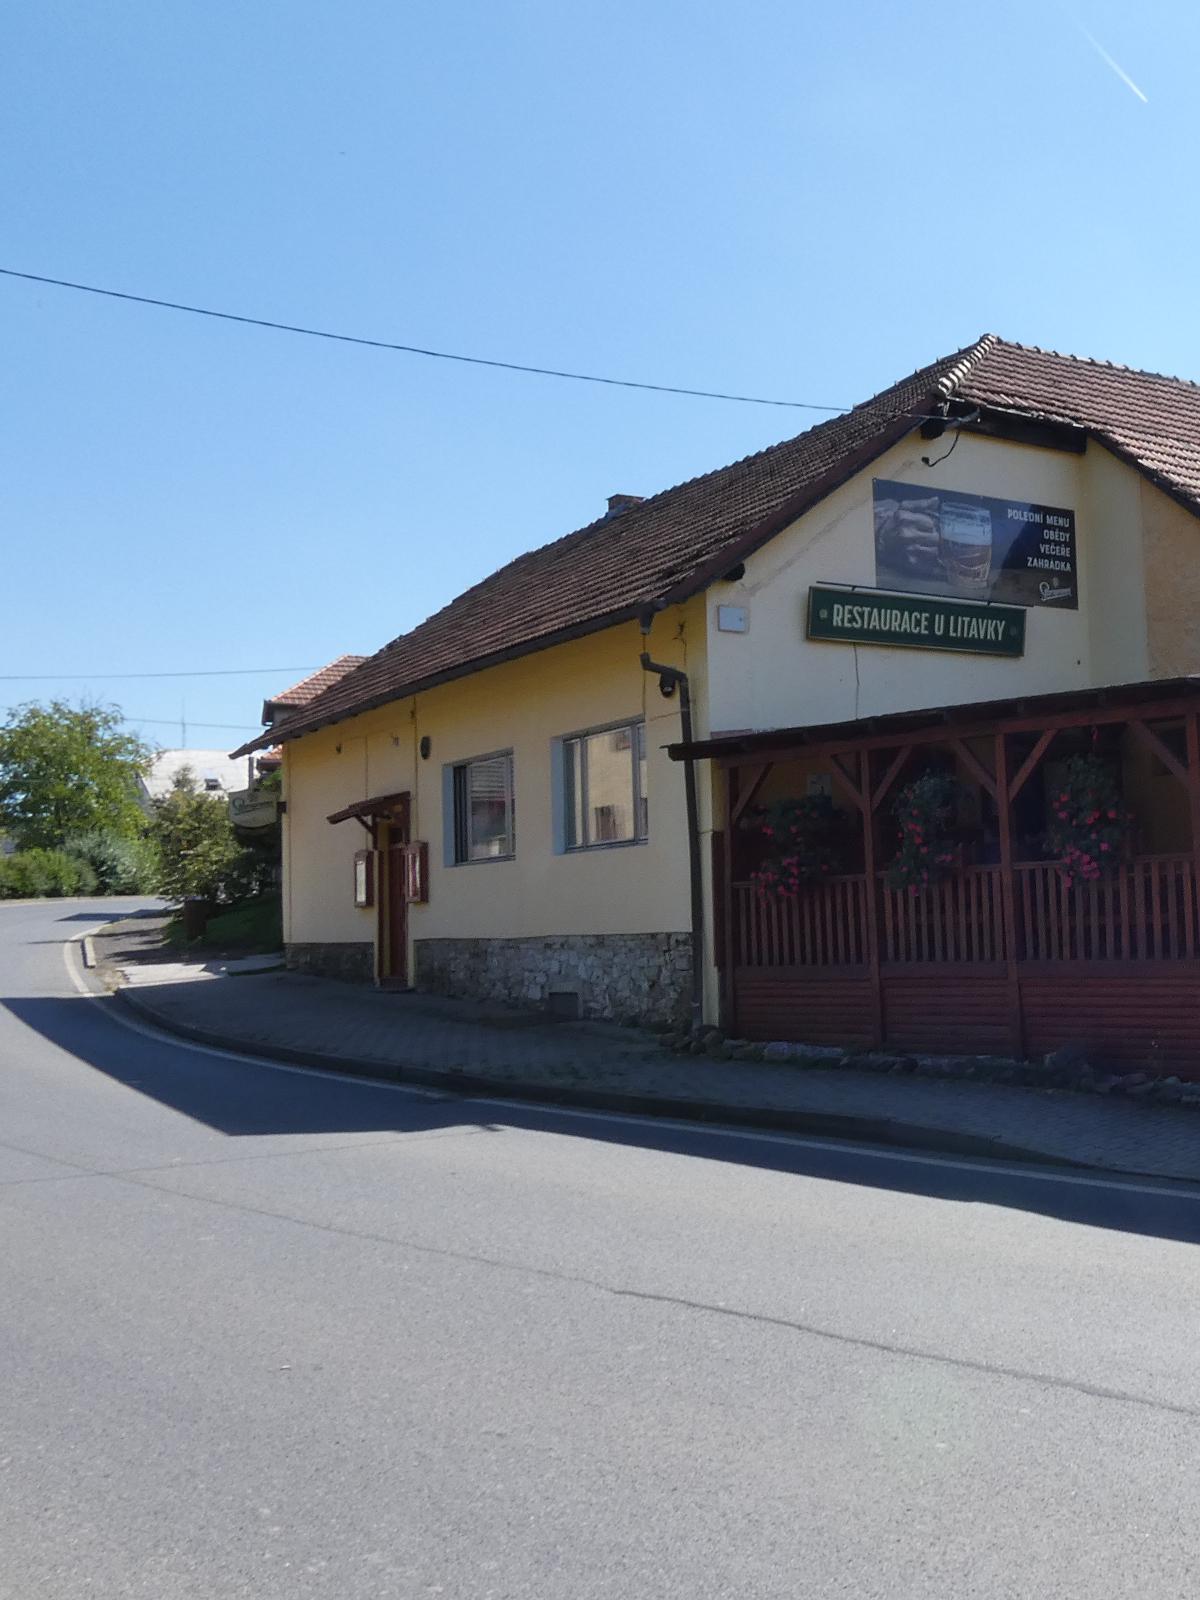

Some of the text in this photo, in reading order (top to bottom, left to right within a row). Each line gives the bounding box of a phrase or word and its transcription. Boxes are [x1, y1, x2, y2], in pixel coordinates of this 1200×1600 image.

[1007, 508, 1070, 527] POLEDNÍ MENU
[1039, 542, 1071, 557] VEČEŘE
[832, 603, 1006, 641] RESTAURACE U LITAVKY
